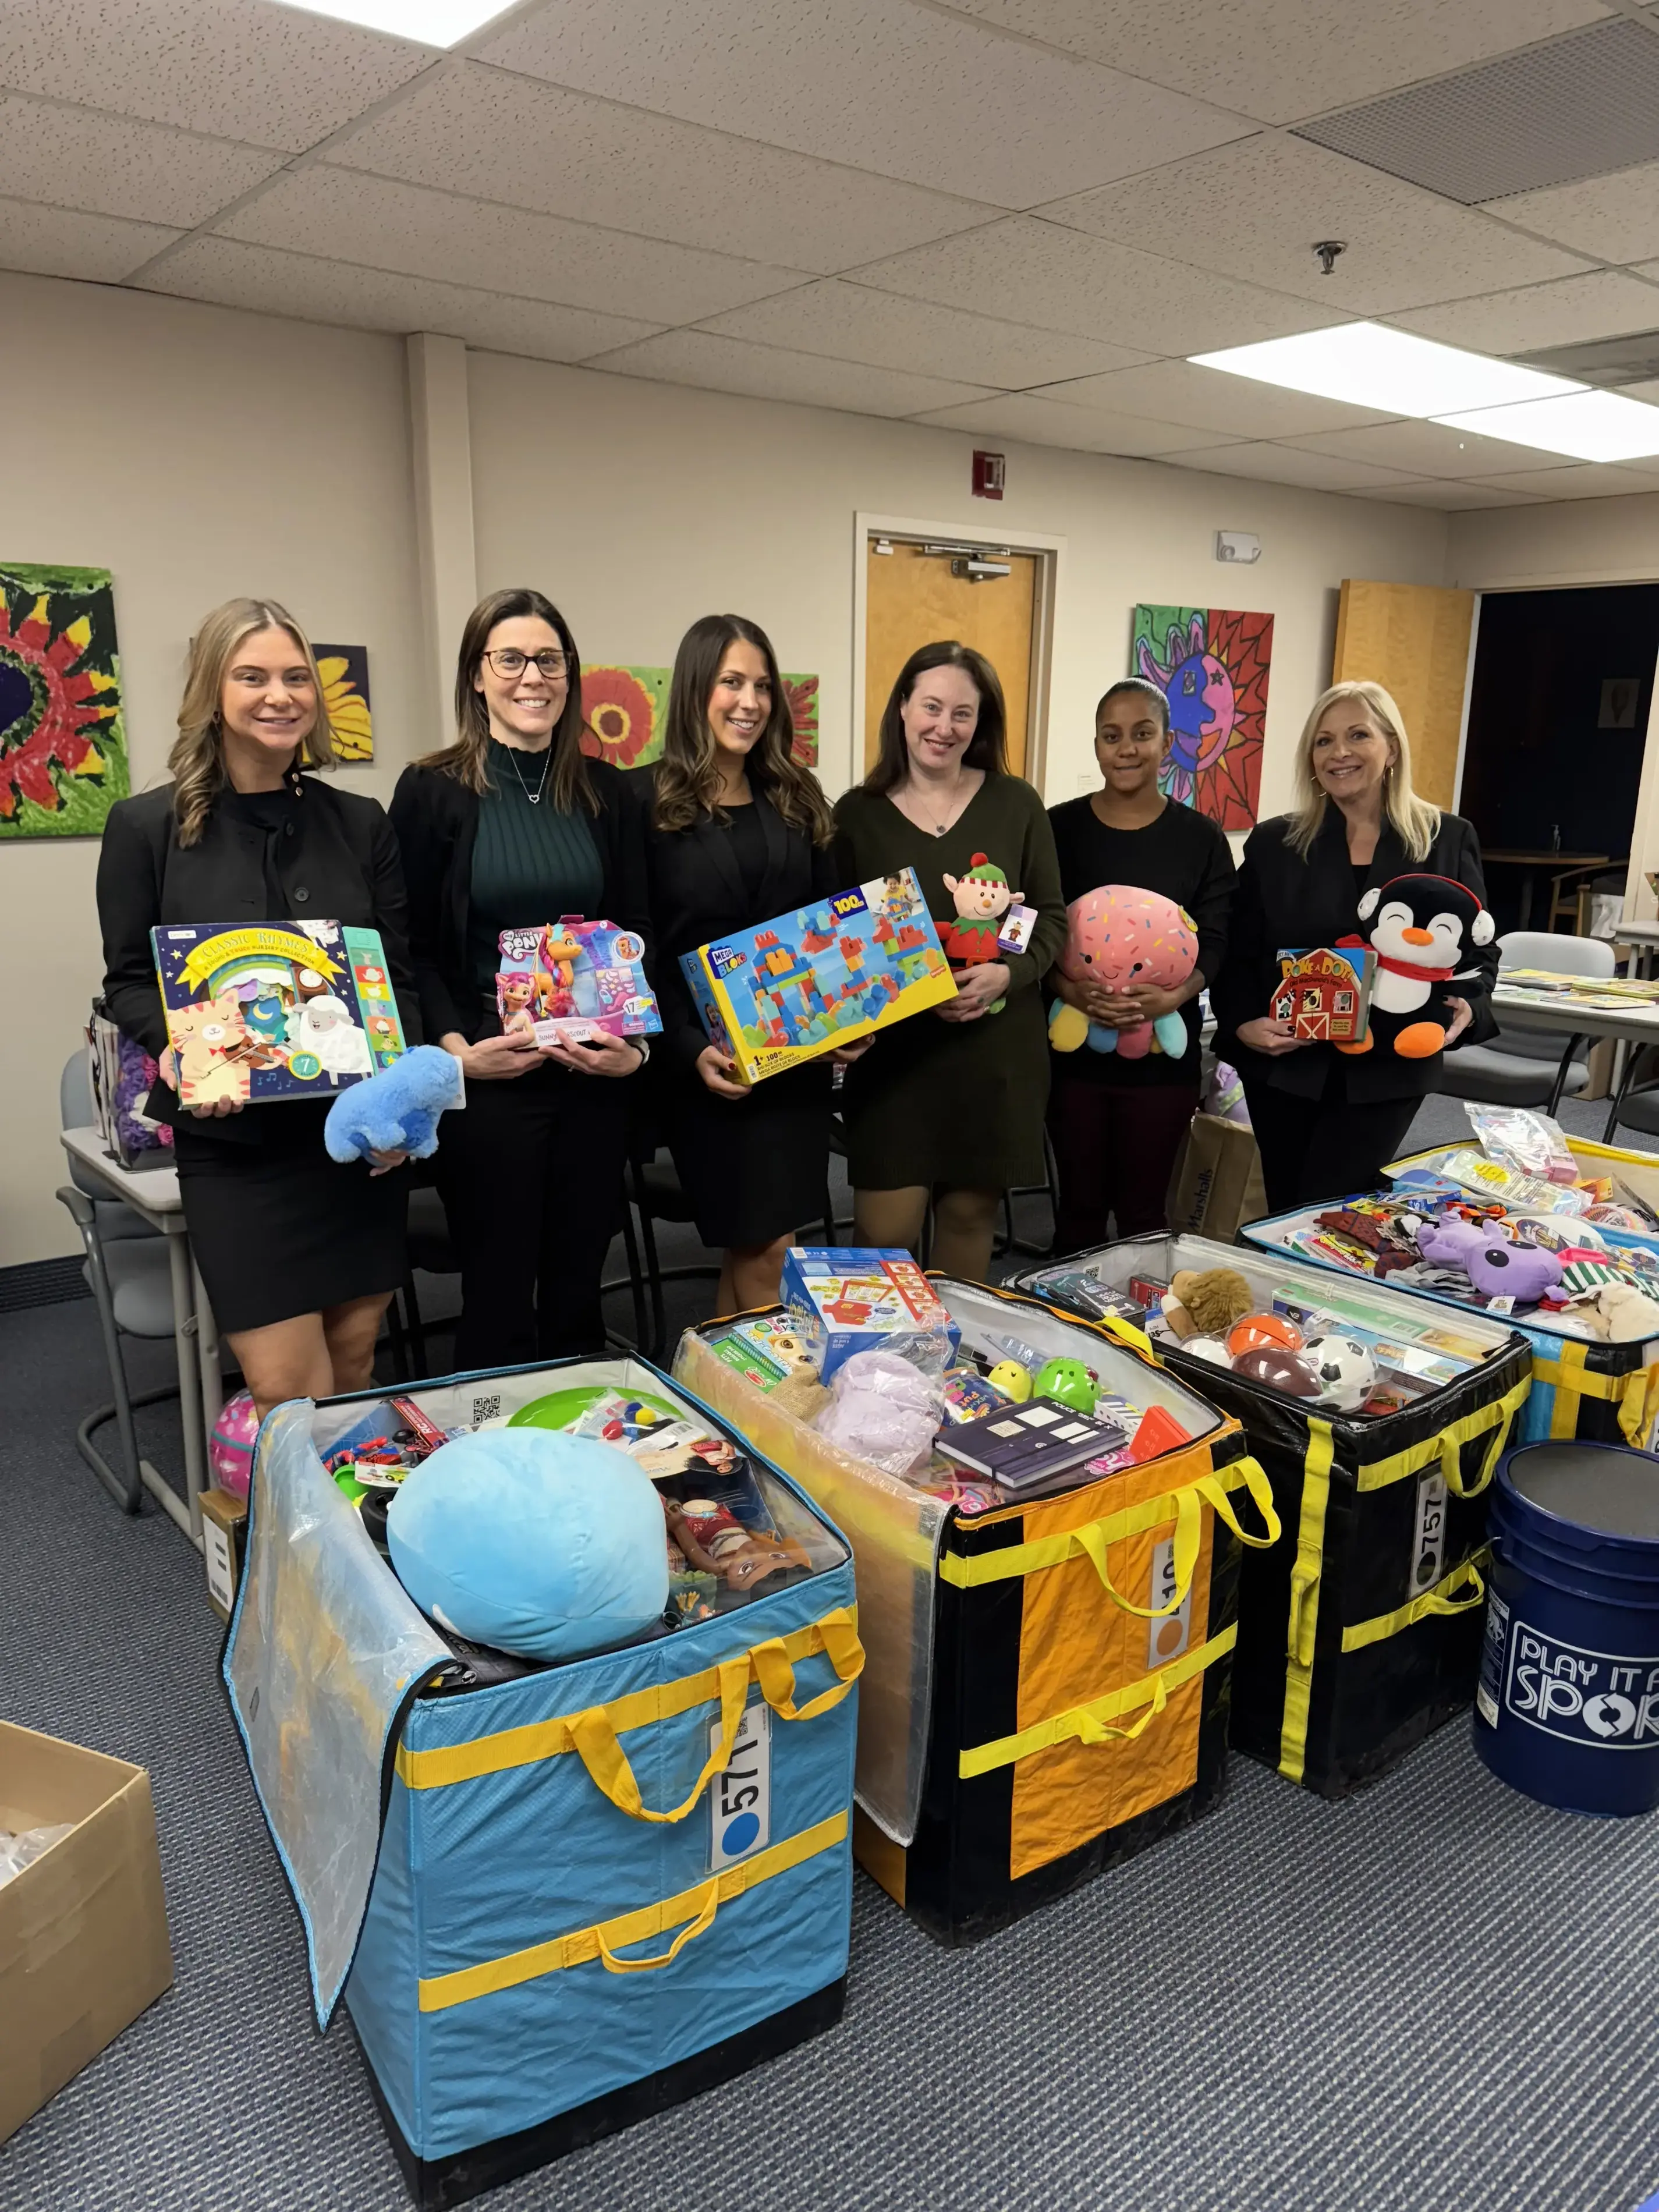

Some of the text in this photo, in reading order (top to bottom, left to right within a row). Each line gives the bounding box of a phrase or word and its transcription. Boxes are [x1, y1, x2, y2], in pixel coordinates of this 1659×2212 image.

[834, 895, 859, 914] 100
[202, 934, 250, 958] CLASSIC
[257, 931, 310, 953] RHYMES
[502, 933, 544, 956] PONY
[208, 953, 225, 967] SOUND
[231, 946, 251, 955] TOUCH
[280, 947, 315, 965] COLLECTION
[714, 949, 733, 962] MEGA
[717, 952, 747, 978] BLOKS
[625, 1002, 635, 1013] 17
[538, 1033, 557, 1041] SUNNY
[301, 1058, 310, 1073] 7
[1187, 1168, 1213, 1234] Marshalls
[1051, 1402, 1077, 1414] POLICE
[416, 1422, 434, 1434] RC
[1421, 1498, 1442, 1554] 757
[1520, 1635, 1598, 1686] PLAY
[1610, 1667, 1643, 1693] IT
